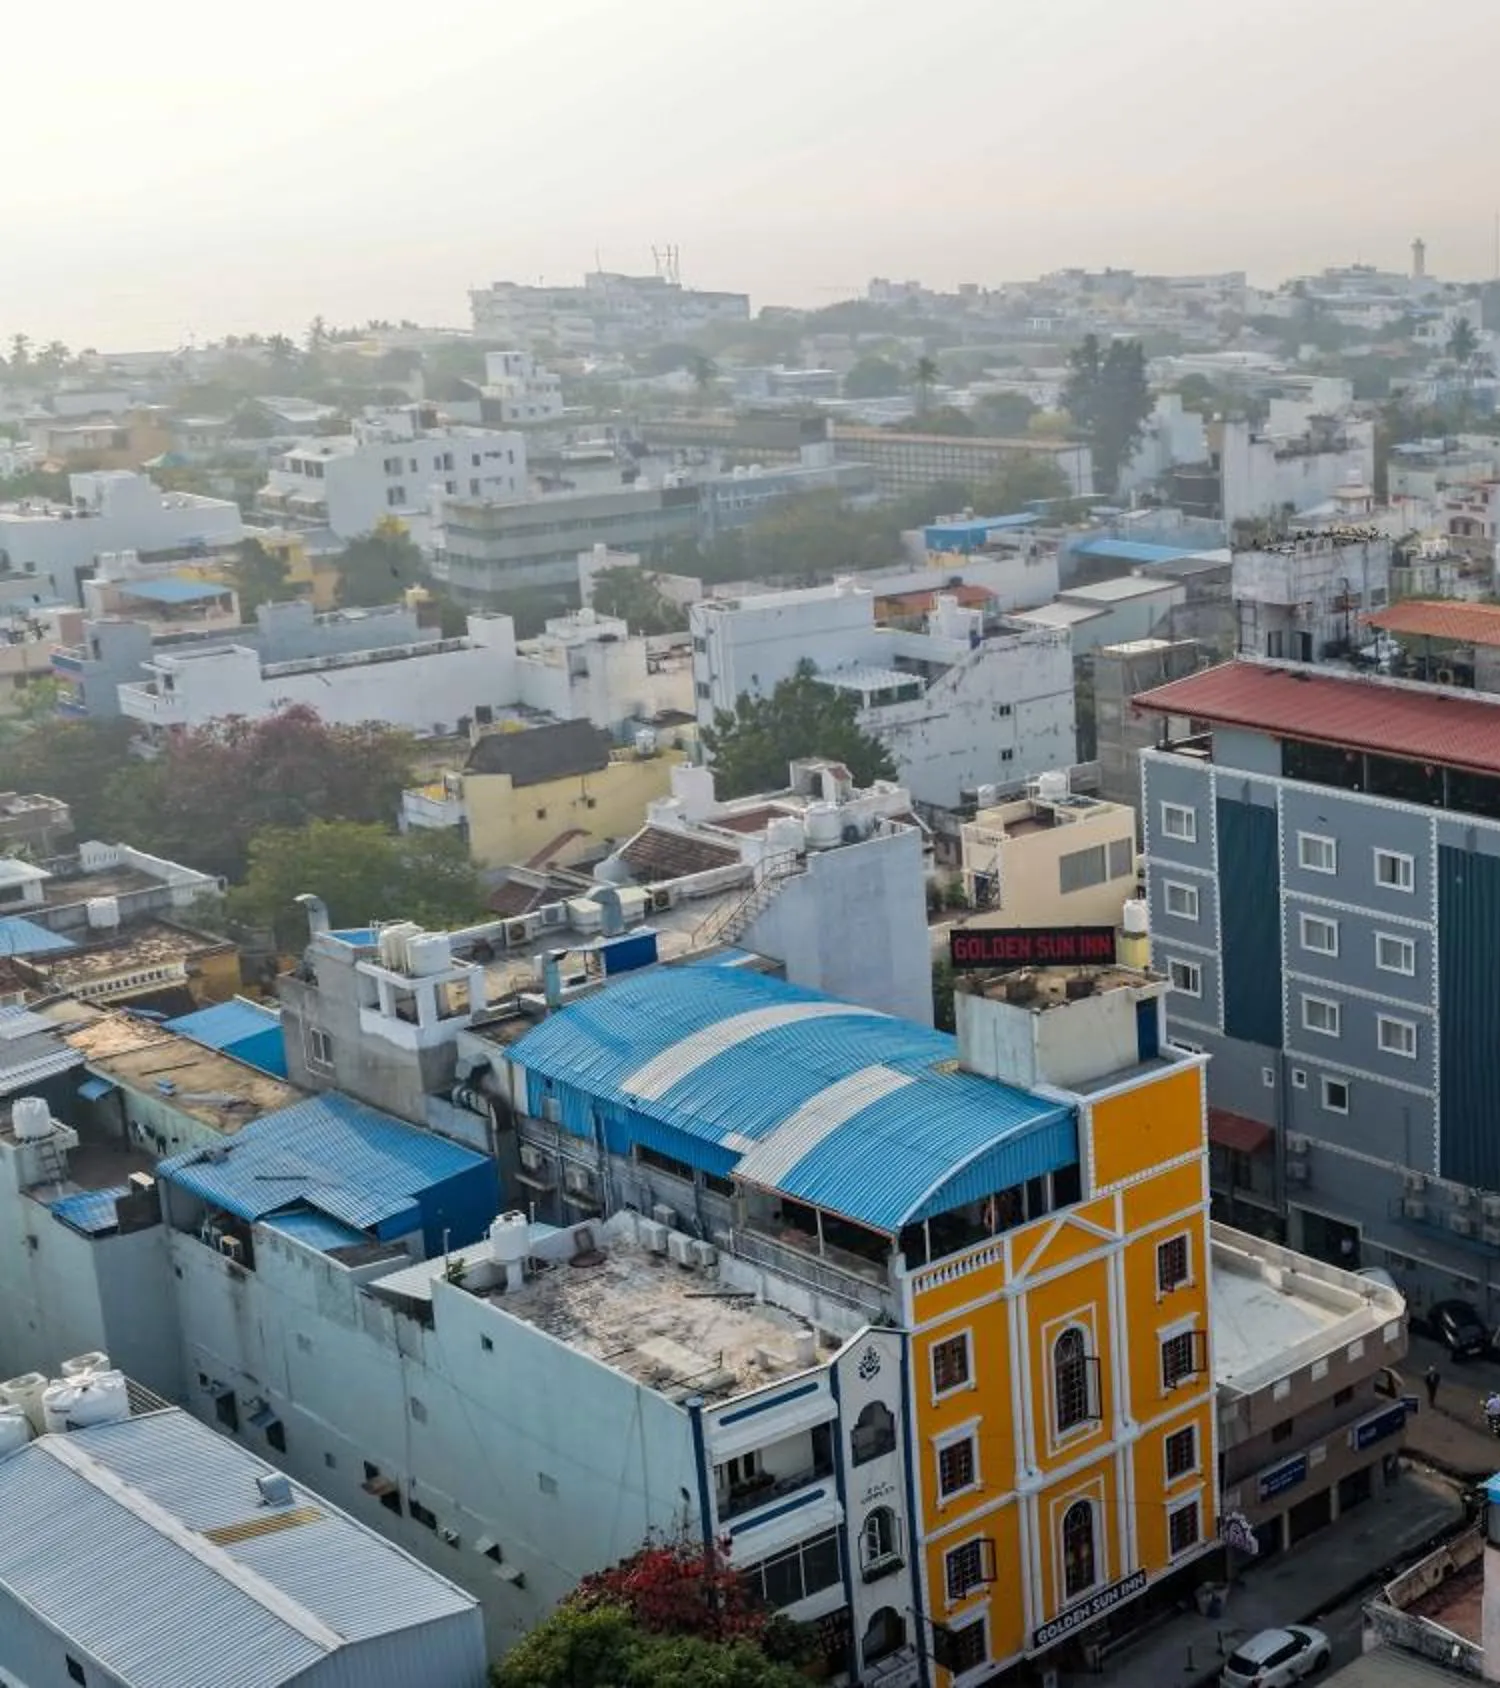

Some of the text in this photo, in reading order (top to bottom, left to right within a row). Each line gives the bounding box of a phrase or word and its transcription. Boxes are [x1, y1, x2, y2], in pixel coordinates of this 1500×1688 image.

[954, 934, 1112, 960] GOLDEN SUN INN
[1037, 1573, 1145, 1643] GOLDEN SUN INN
